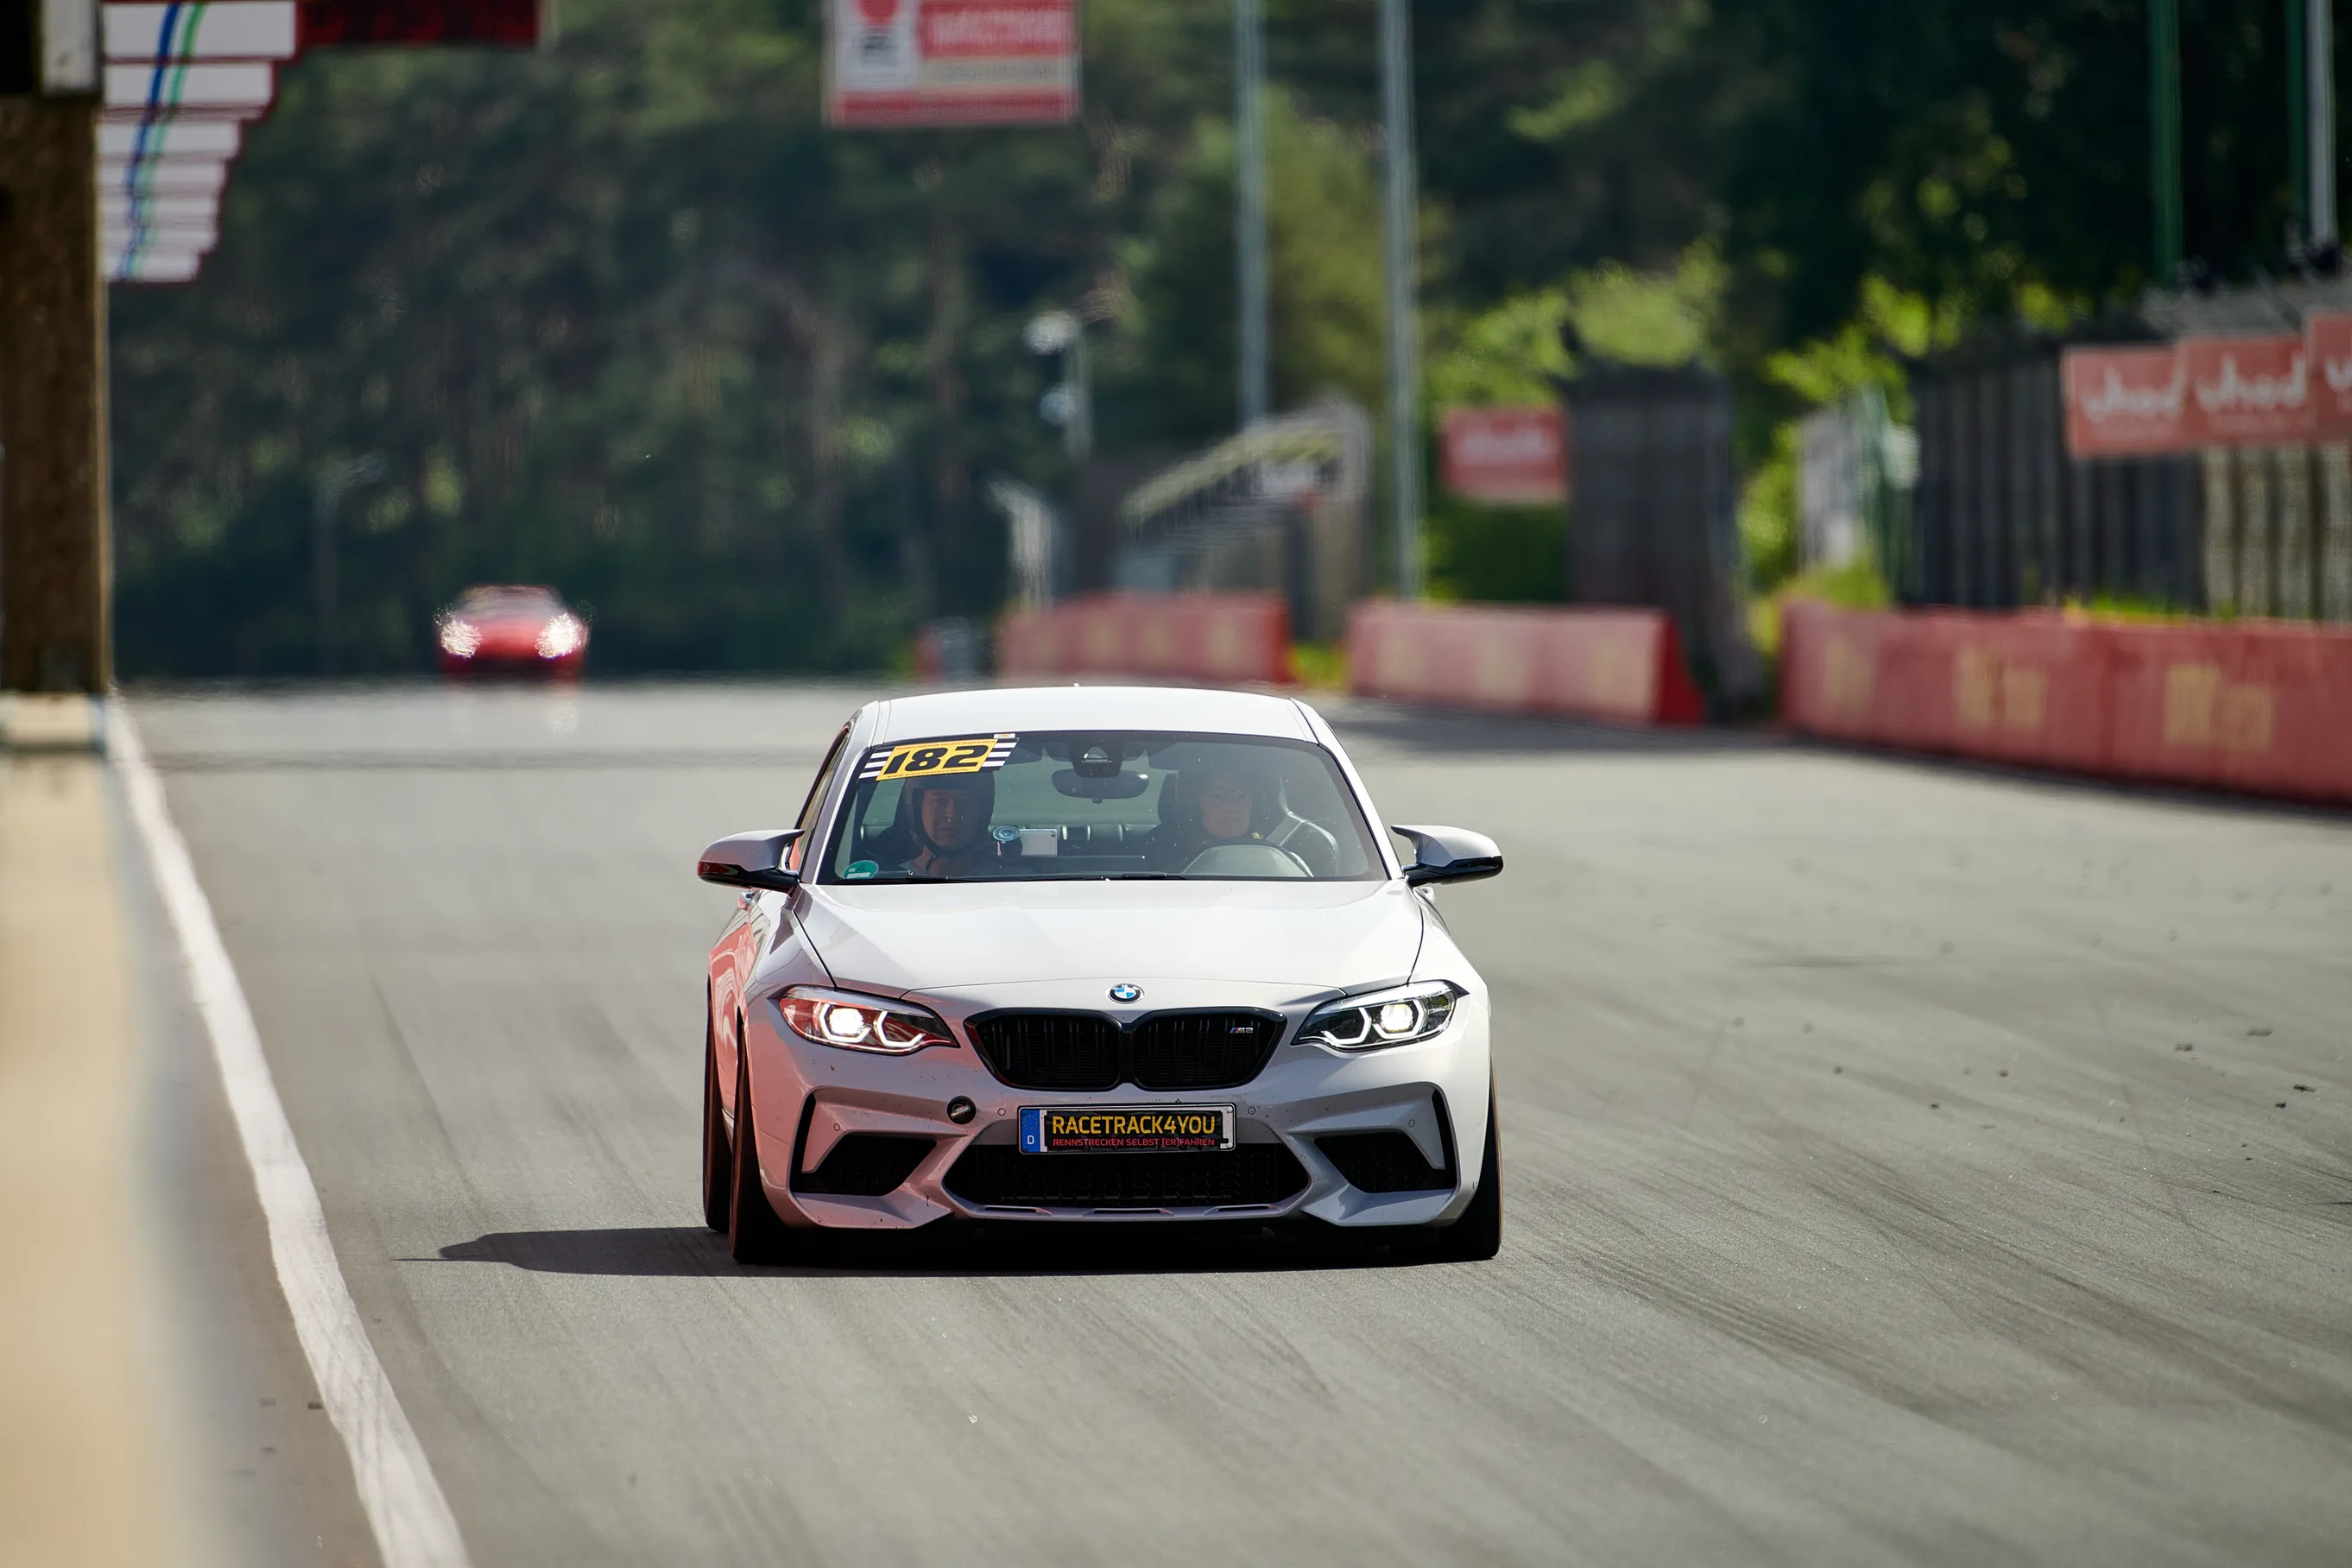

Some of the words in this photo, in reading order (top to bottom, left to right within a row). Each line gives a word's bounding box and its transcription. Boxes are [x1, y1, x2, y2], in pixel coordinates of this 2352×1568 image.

[883, 745, 989, 775] 182
[1053, 1116, 1216, 1135] RACETRACK4YOU
[1027, 1135, 1035, 1145] D
[1053, 1138, 1124, 1147] RENNSTRECKEN
[1125, 1138, 1160, 1147] SELBST
